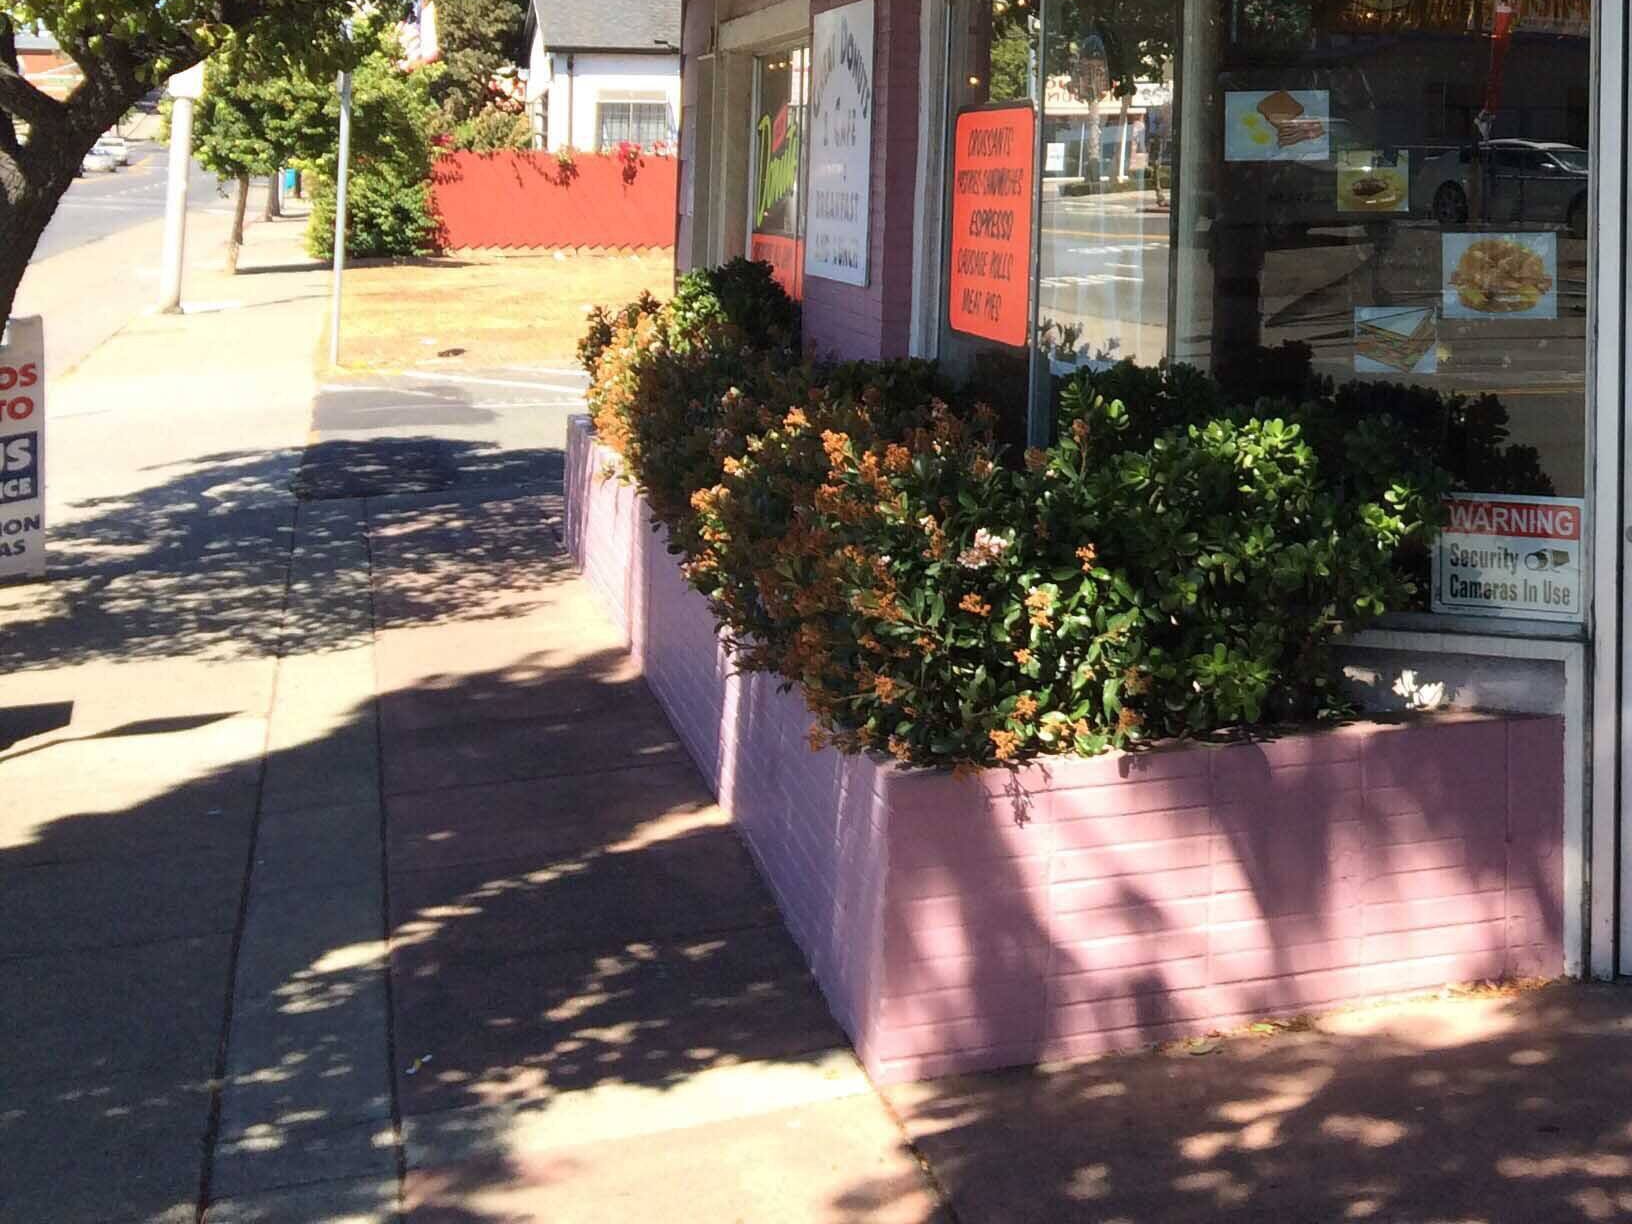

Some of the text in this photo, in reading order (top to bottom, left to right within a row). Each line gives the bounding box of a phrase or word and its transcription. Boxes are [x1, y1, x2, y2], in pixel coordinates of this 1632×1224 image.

[0, 438, 31, 471] S
[0, 477, 32, 499] CE
[0, 513, 40, 536] ON
[1449, 504, 1574, 536] WARNING
[1449, 542, 1519, 576] Security
[1449, 574, 1571, 606] Cameras In Use
